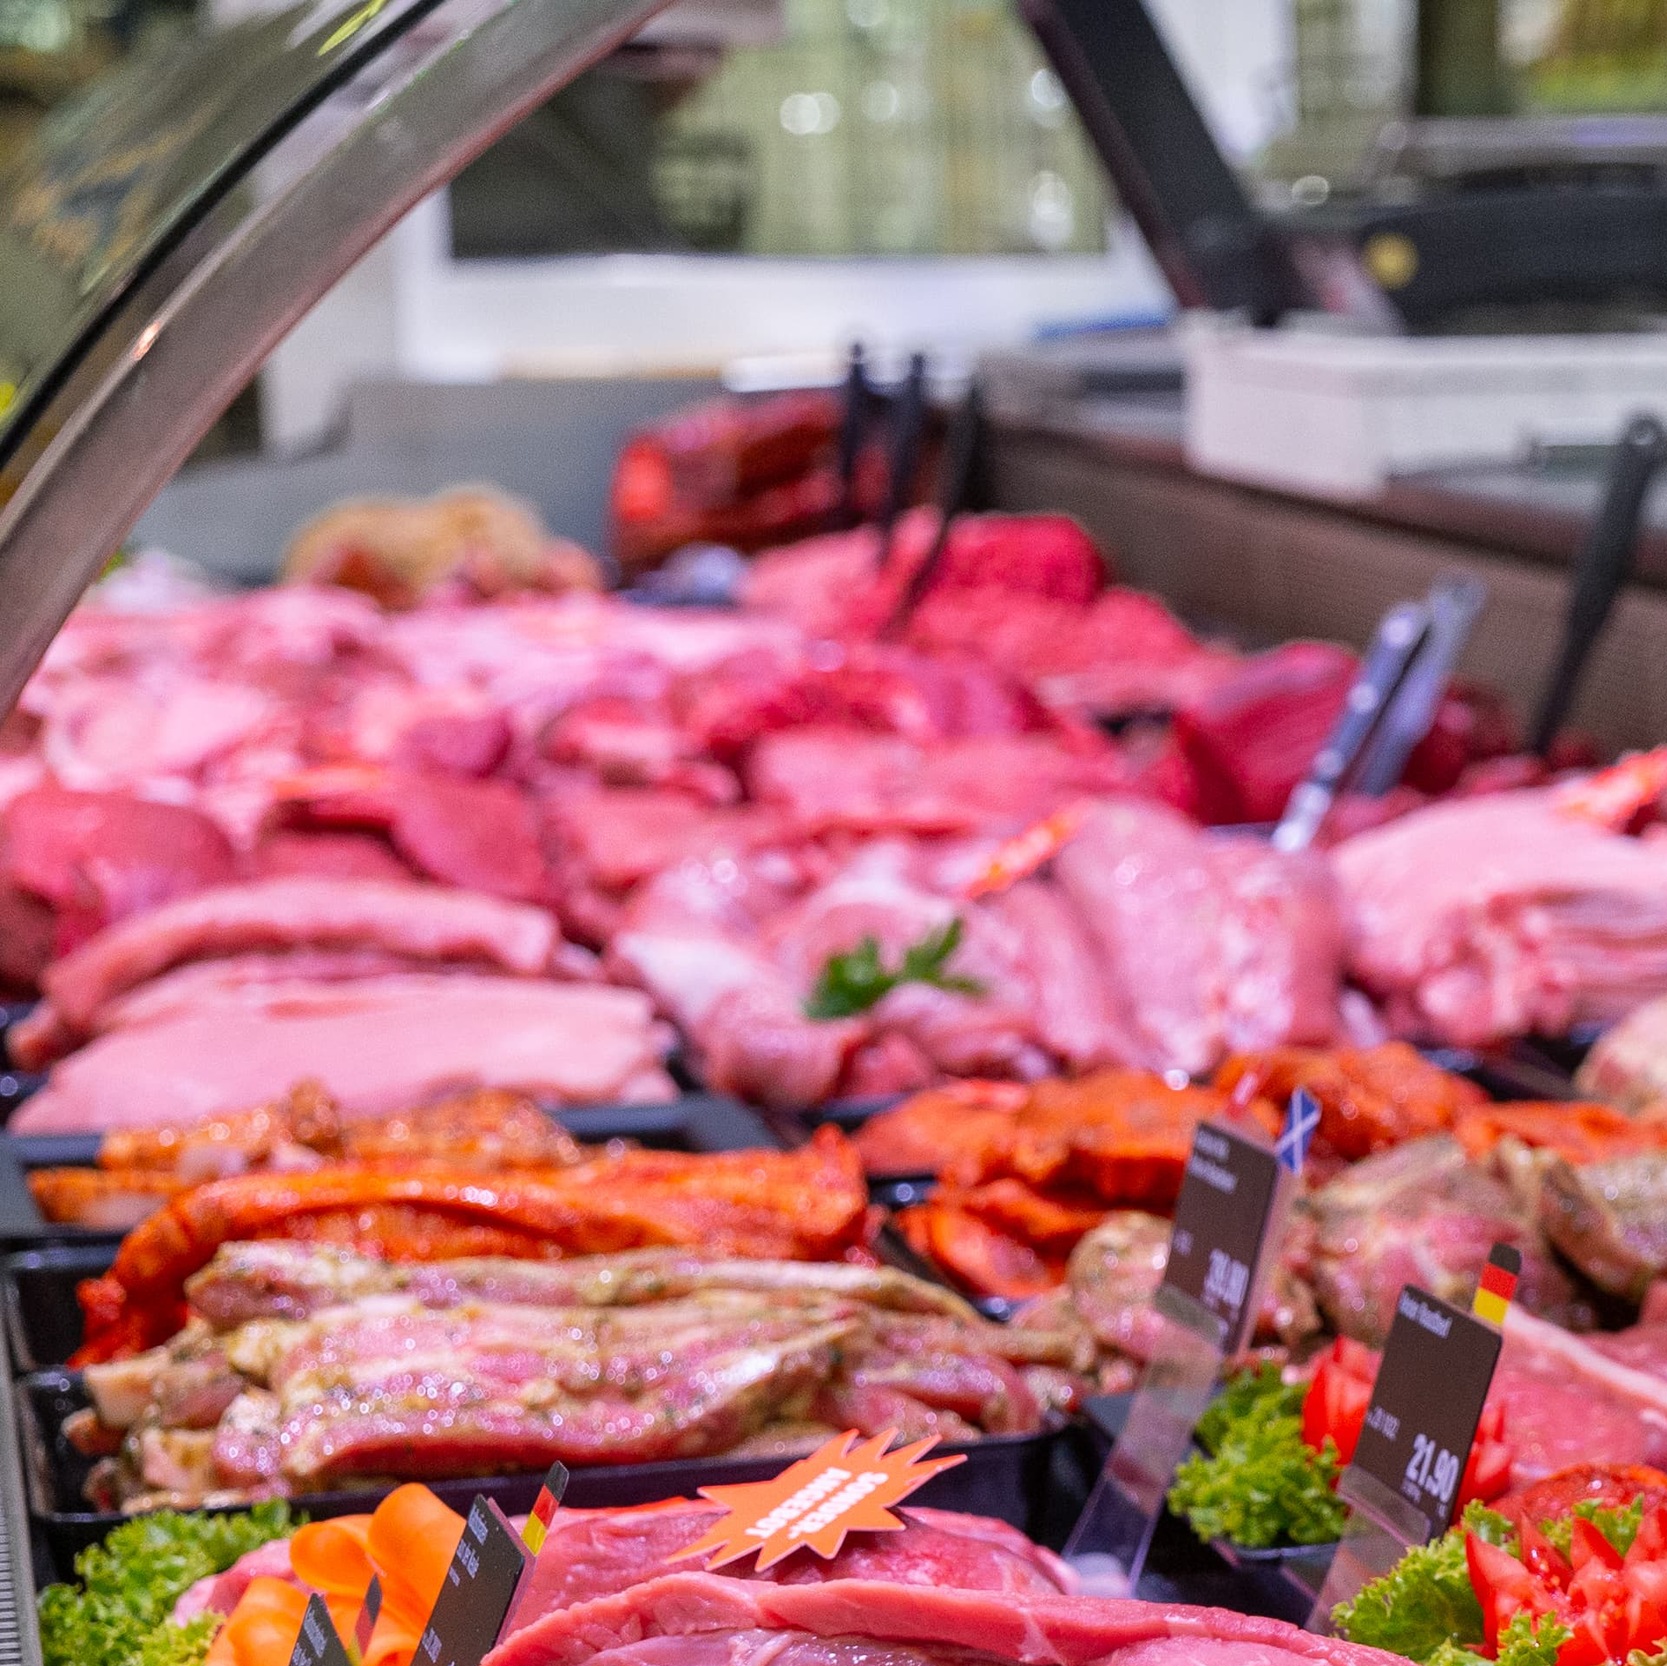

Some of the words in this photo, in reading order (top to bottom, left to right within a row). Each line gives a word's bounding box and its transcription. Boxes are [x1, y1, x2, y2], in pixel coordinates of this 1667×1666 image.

[744, 1467, 852, 1538] ANGEBOT
[1406, 1433, 1459, 1503] 21.90
[788, 1471, 889, 1539] SONDER-
